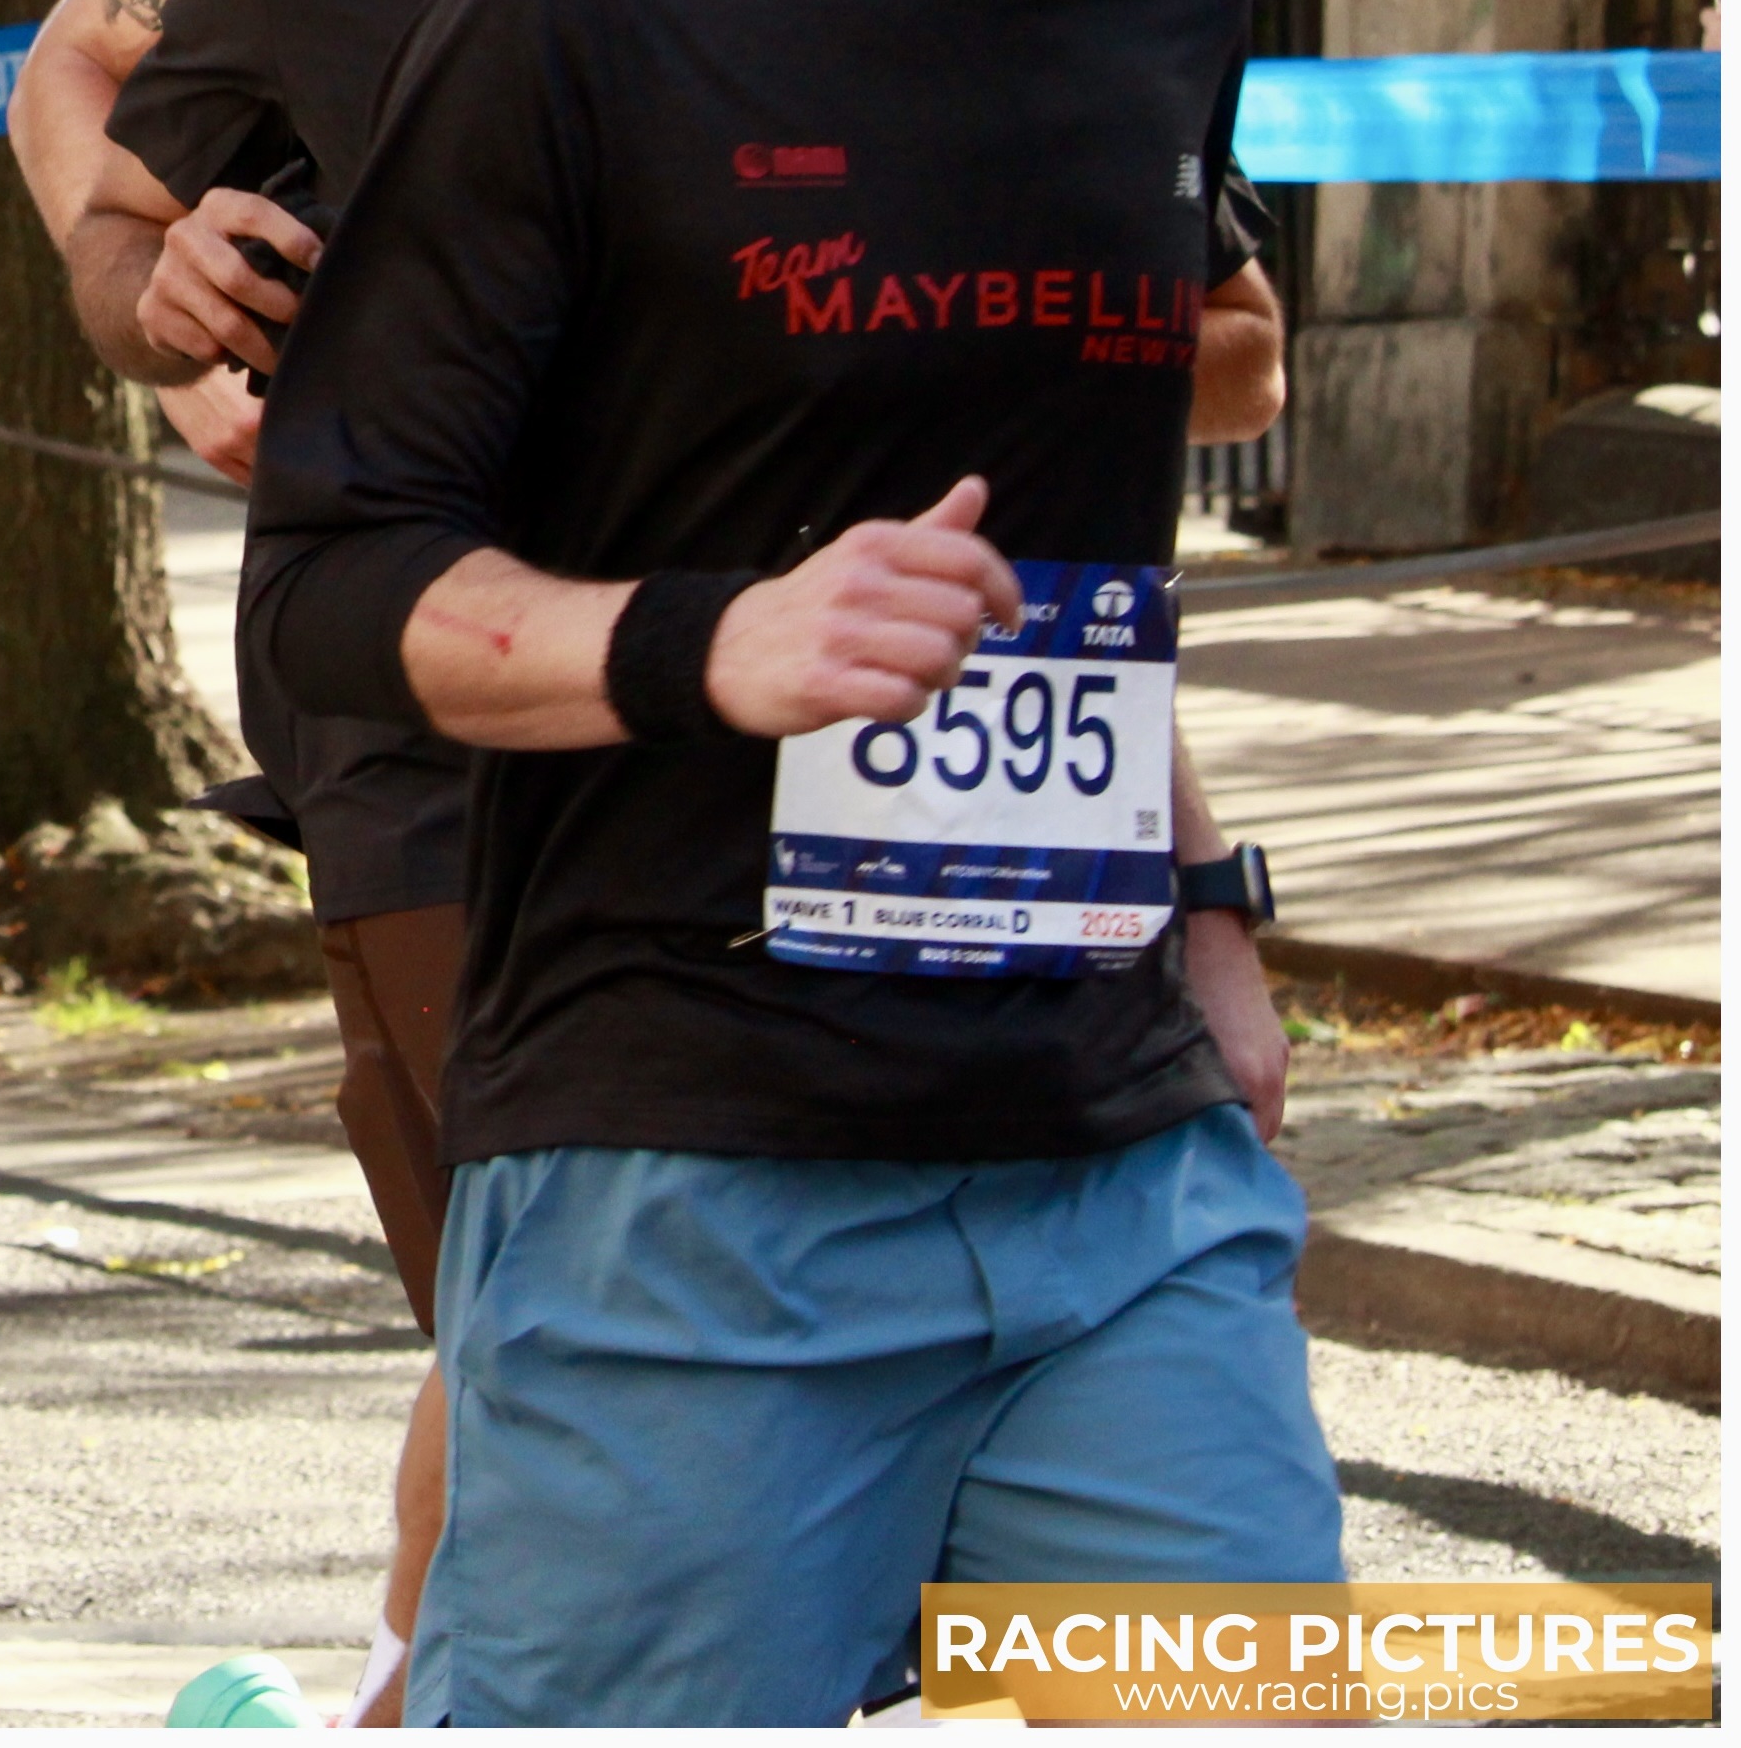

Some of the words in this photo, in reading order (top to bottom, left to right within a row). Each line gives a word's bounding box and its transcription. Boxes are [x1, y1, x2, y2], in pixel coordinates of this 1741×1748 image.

[733, 231, 865, 300] Team
[1082, 624, 1137, 648] TATA
[773, 899, 834, 920] WAVE
[842, 900, 856, 926] 1
[874, 908, 925, 928] BLUE
[931, 911, 1007, 931] CORRAL
[1011, 907, 1031, 935] D
[1080, 910, 1144, 939] 2025
